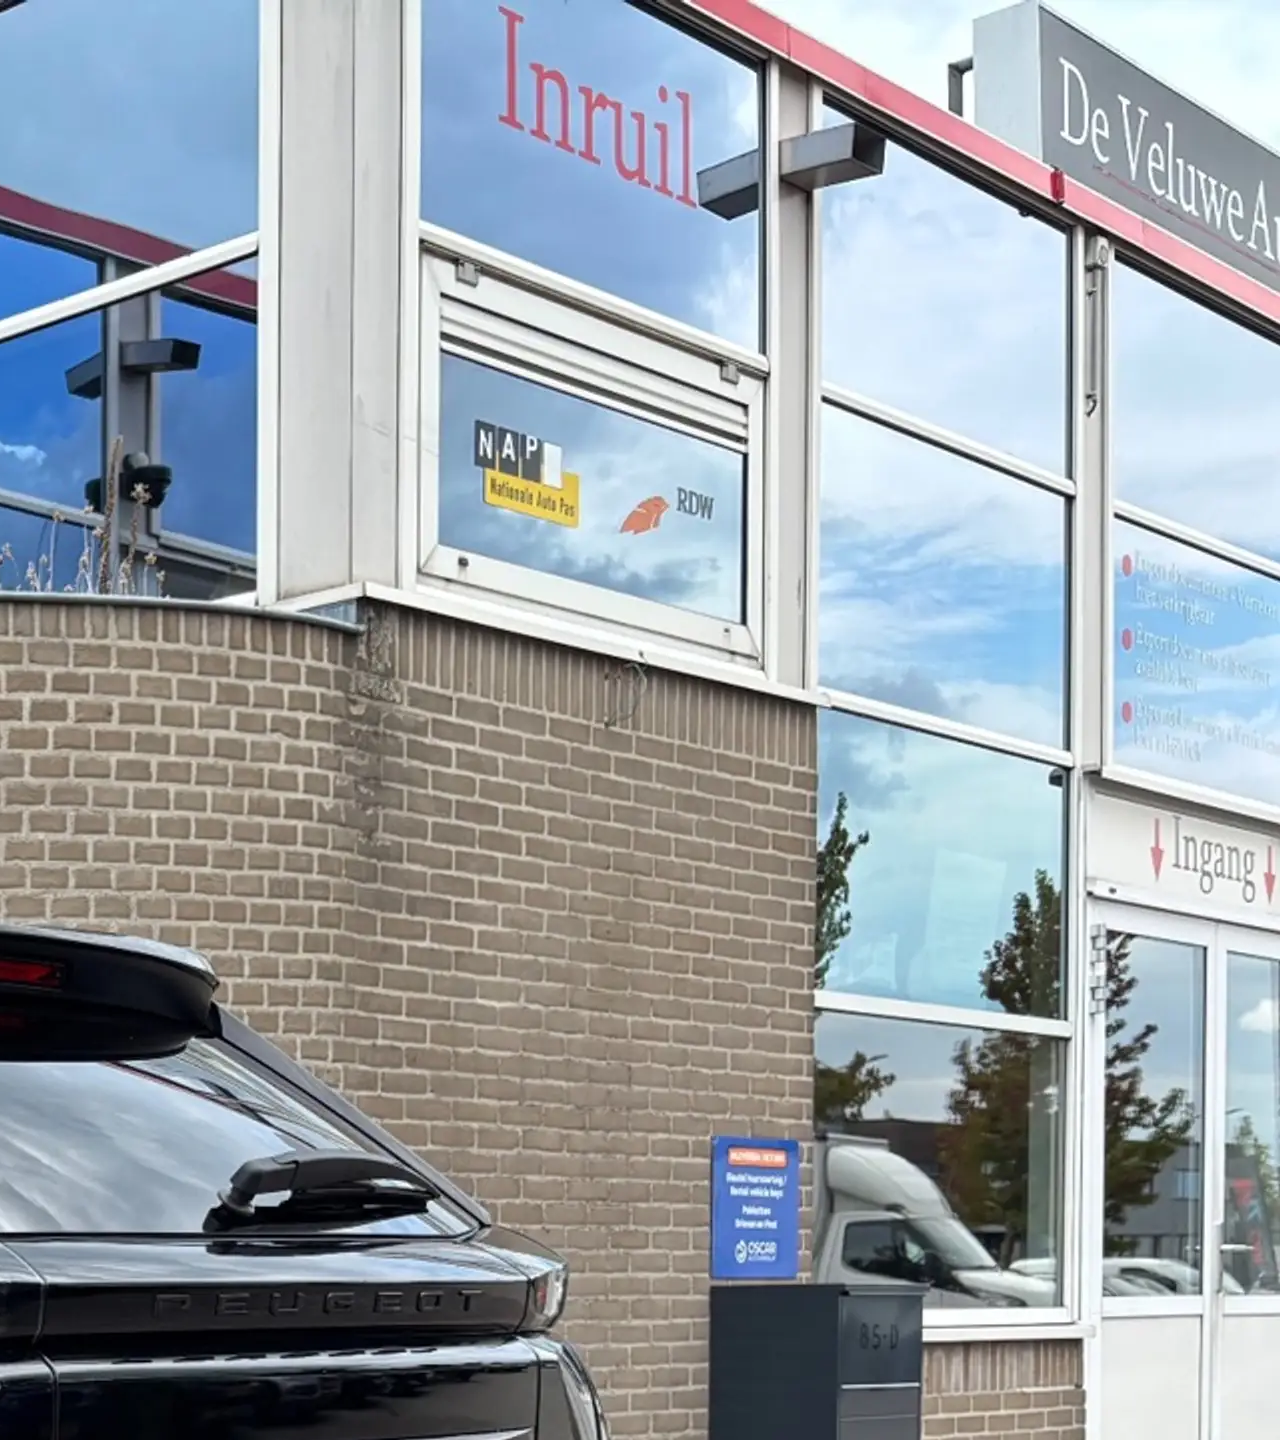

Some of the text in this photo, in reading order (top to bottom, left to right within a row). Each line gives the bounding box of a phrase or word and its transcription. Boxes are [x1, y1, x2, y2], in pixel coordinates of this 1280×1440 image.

[498, 5, 697, 209] Inruil
[1059, 56, 1110, 164] De
[1117, 94, 1245, 242] Veluwe
[479, 429, 539, 463] NAP
[676, 486, 715, 520] RDW
[1172, 815, 1256, 903] Ingang
[152, 1290, 483, 1318] PEUGEOT
